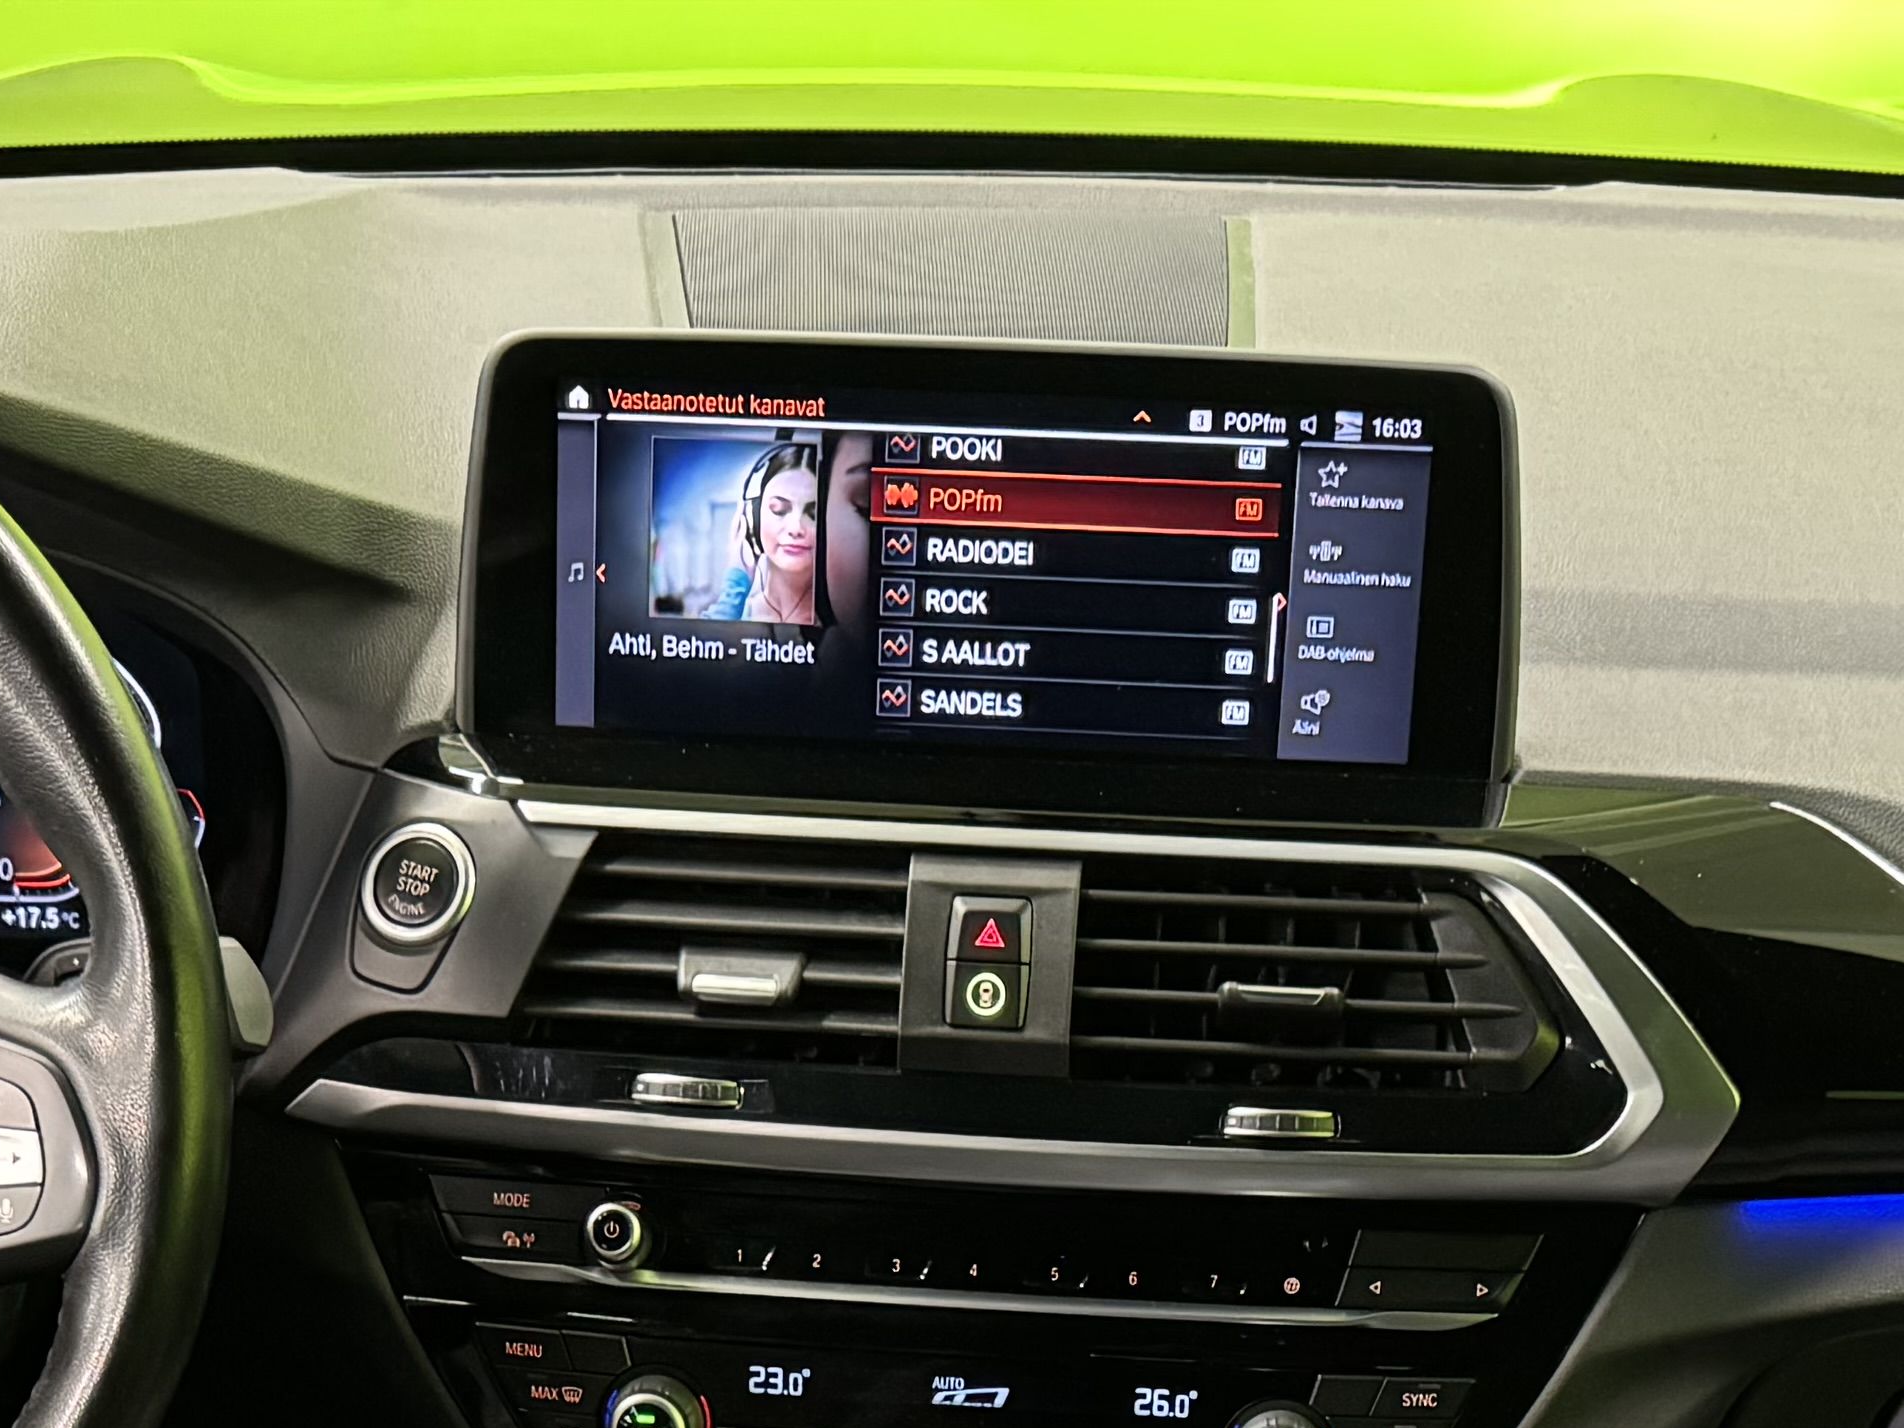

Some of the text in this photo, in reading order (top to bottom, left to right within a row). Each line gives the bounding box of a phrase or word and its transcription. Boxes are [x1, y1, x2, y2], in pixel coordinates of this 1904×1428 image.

[607, 387, 826, 418] Vastaanotetut kanavat
[1223, 411, 1287, 434] POPfm
[1372, 417, 1423, 439] 16:03
[930, 436, 1003, 462] POOKI
[928, 487, 1004, 514] POPfm
[926, 540, 1034, 567] RADIODEI
[924, 588, 989, 616] ROCK
[608, 632, 657, 660] Ahti,
[662, 635, 725, 659] Behm
[741, 638, 816, 664] Tähdet
[922, 639, 939, 664] S
[941, 641, 1032, 668] AALLOT
[919, 688, 1024, 718] SANDELS
[399, 859, 439, 883] START
[396, 876, 431, 897] STOP
[387, 893, 426, 916] ENGINE
[493, 1192, 531, 1208] MODE
[812, 1253, 822, 1269] 2
[892, 1258, 901, 1273] 3
[969, 1263, 978, 1277] 4
[1050, 1267, 1059, 1282] 5
[1129, 1271, 1138, 1286] 6
[1210, 1274, 1219, 1289] 7
[505, 1341, 543, 1358] MENU
[530, 1385, 559, 1401] MAX
[932, 1376, 965, 1390] AUTO
[1402, 1393, 1438, 1408] SYNC
